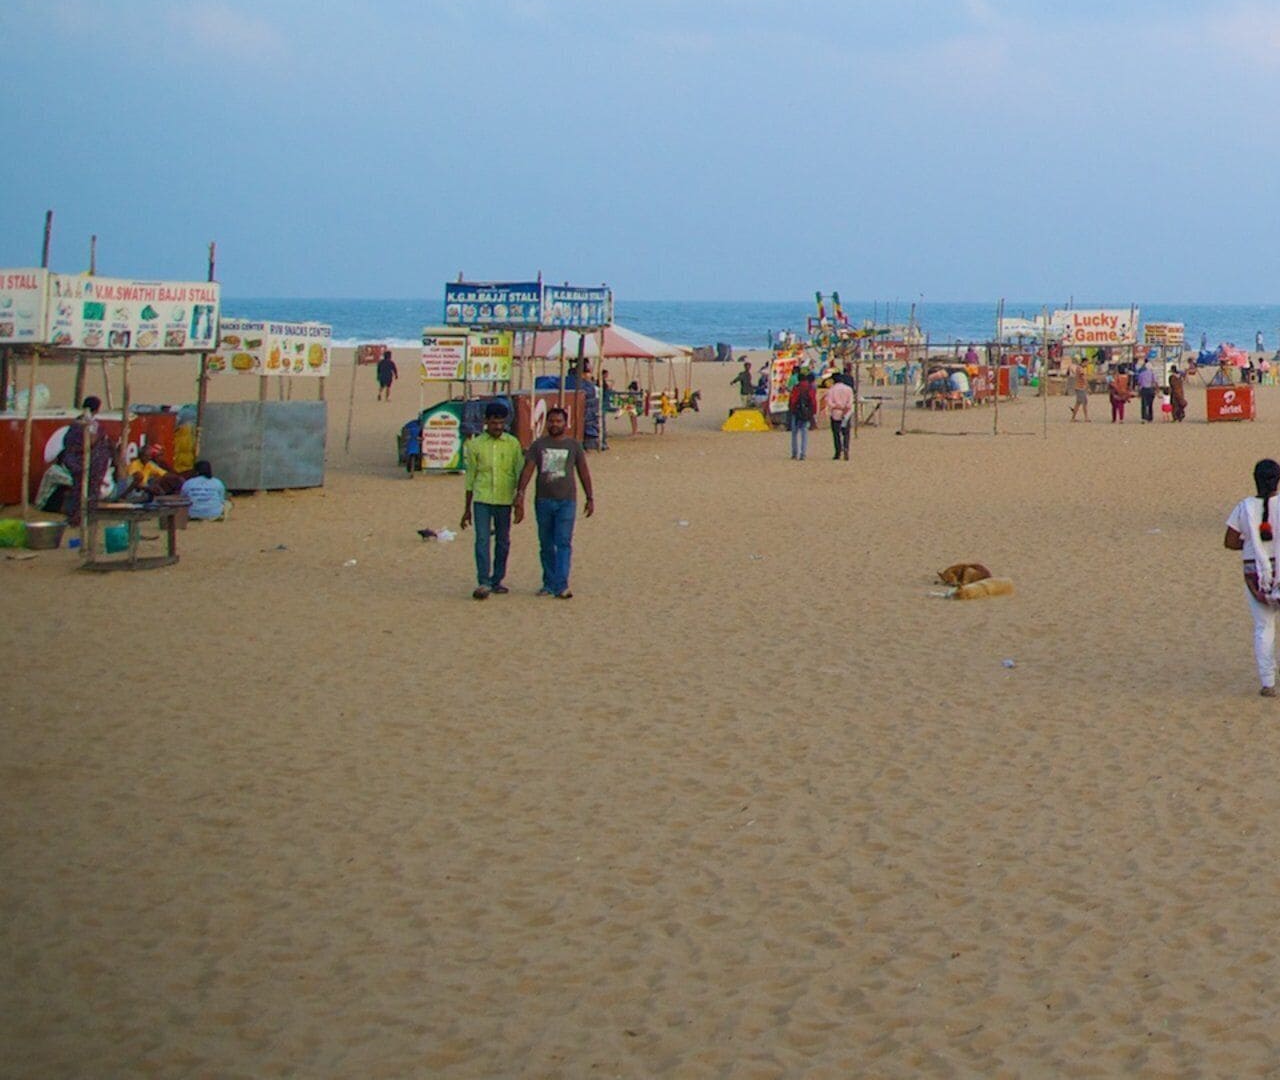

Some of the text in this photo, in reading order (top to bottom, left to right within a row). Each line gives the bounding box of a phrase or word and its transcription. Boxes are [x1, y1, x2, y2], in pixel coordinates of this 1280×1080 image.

[7, 275, 38, 289] STALL
[158, 288, 186, 302] BAJJI
[188, 289, 216, 303] STALL
[508, 290, 539, 303] STALL
[1073, 313, 1118, 329] Lucky
[1075, 328, 1118, 342] Game
[1219, 404, 1243, 415] airtel
